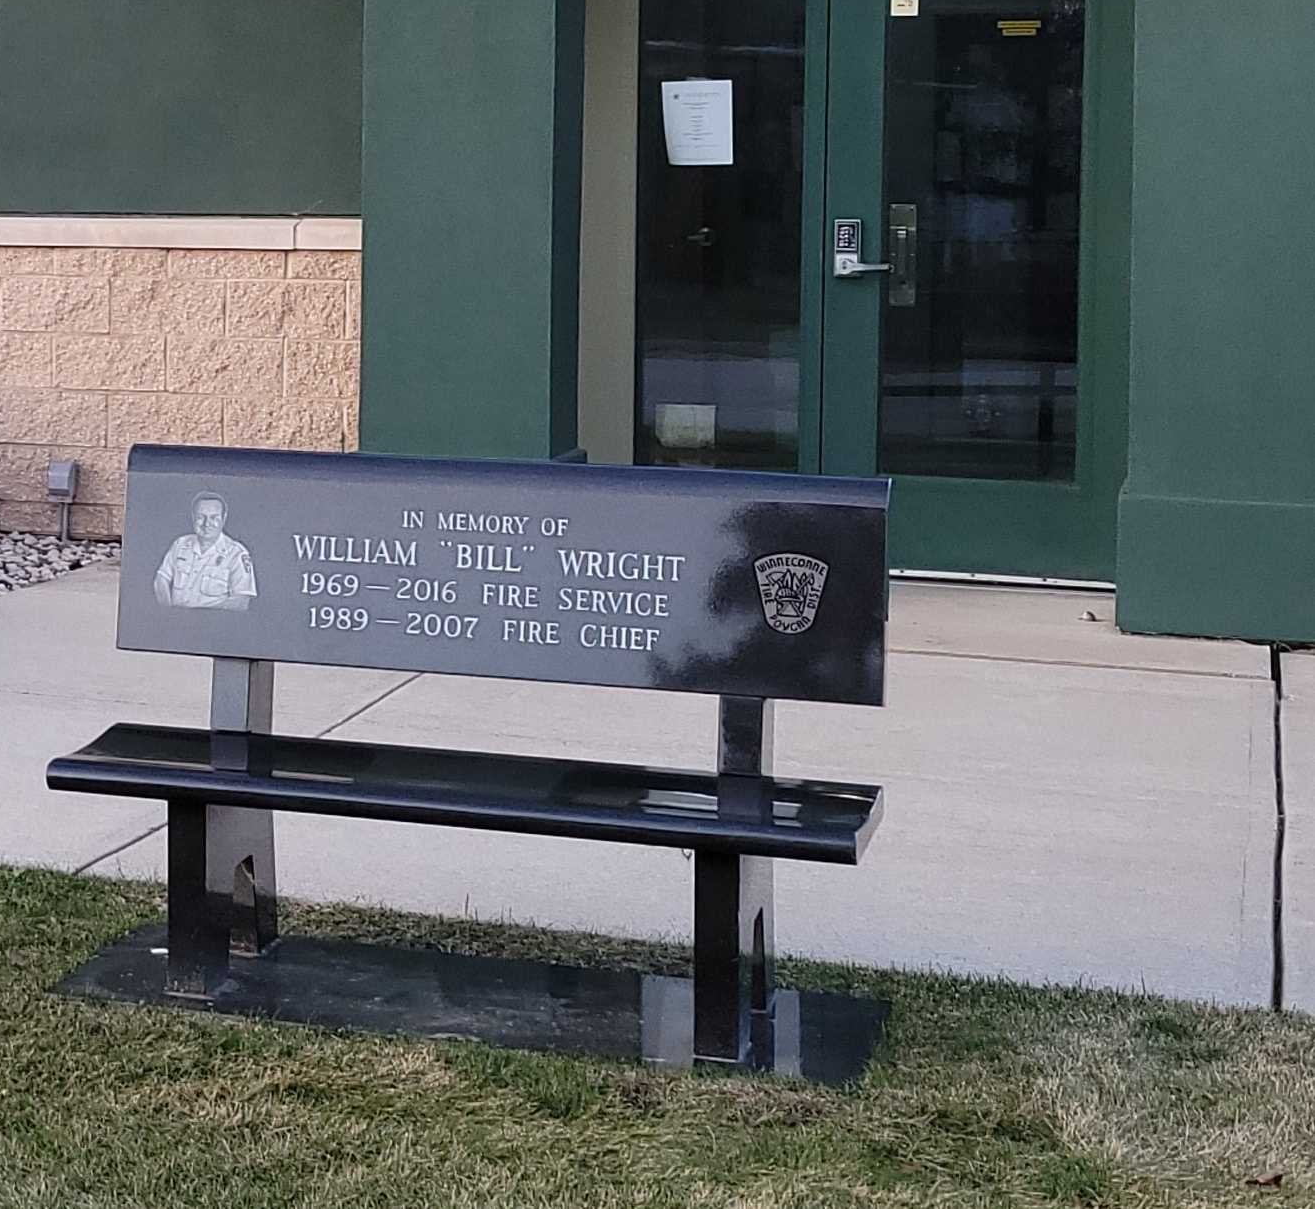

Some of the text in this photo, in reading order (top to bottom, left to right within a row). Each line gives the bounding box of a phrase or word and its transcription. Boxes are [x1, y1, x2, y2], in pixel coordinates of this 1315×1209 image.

[402, 510, 569, 536] IN MEMORY OF
[293, 535, 417, 566] WILLIAM
[558, 549, 686, 581] WRIGHT
[482, 583, 539, 608] FIRE
[558, 588, 670, 617] SERVICE
[503, 619, 560, 645] FIRE
[580, 624, 660, 651] CHIEF
